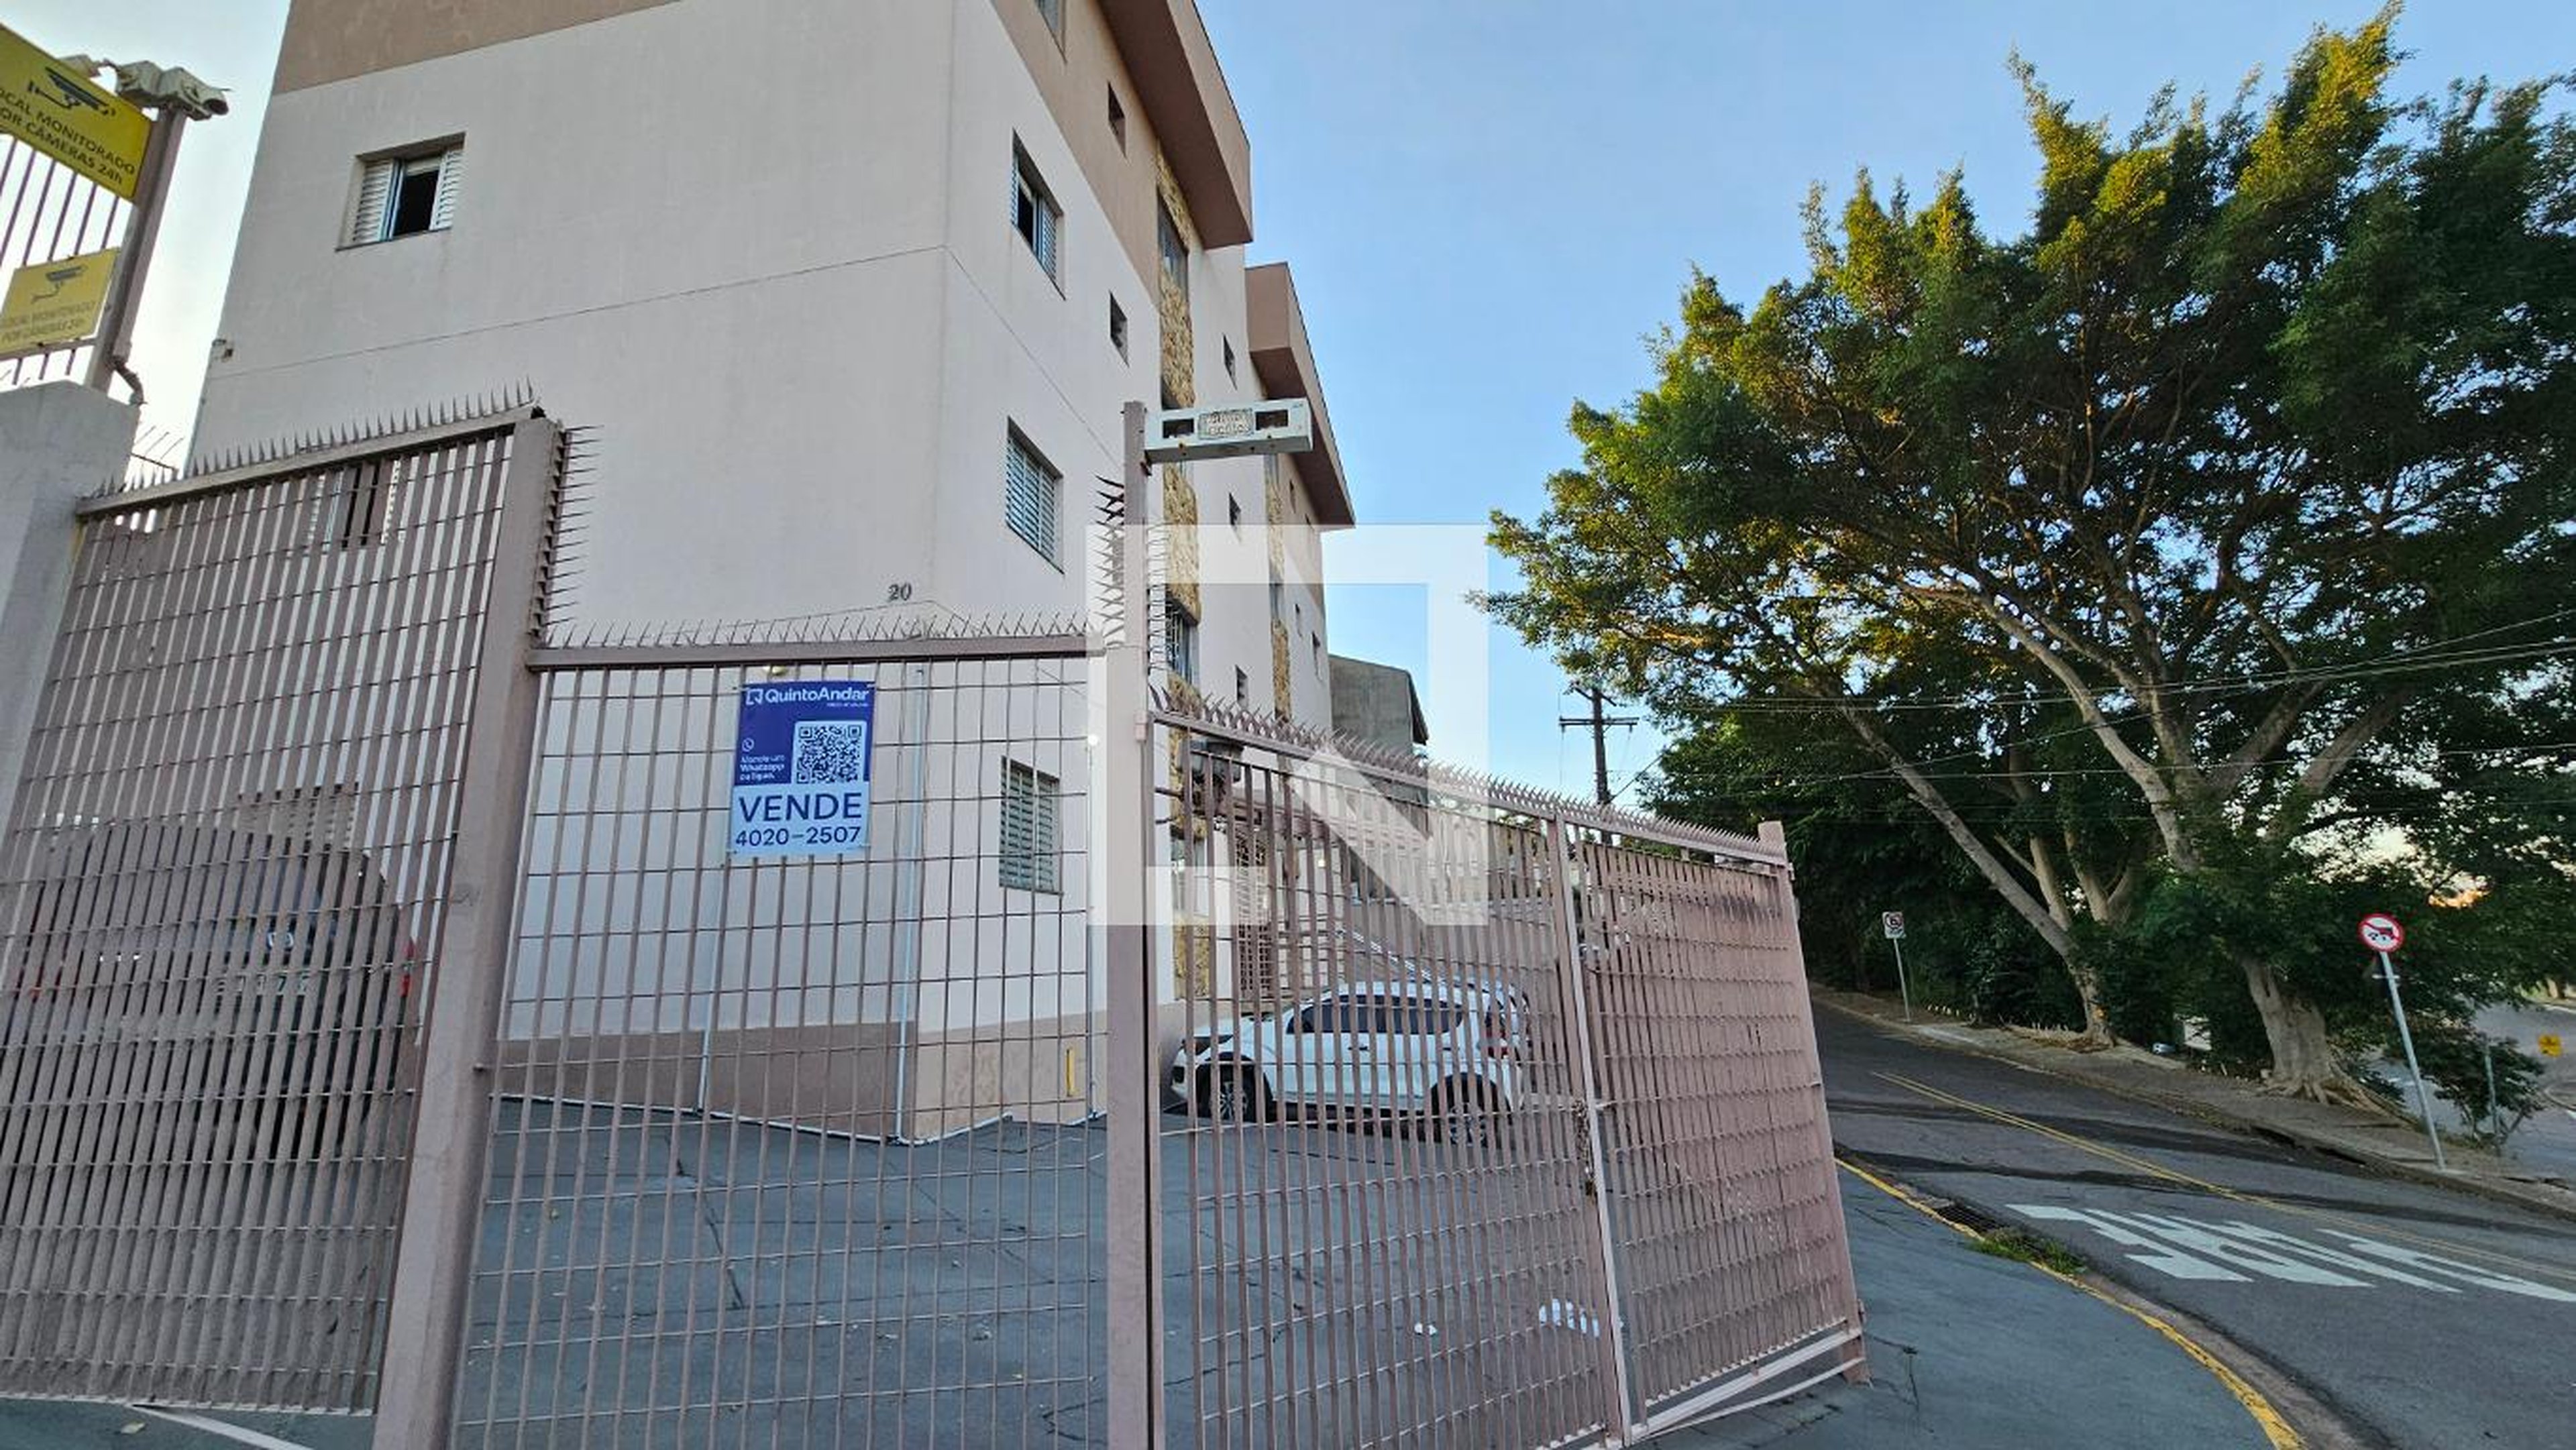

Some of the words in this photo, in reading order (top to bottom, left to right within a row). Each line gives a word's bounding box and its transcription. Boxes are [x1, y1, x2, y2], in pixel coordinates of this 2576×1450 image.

[37, 111, 135, 174] MONITORADO
[888, 582, 912, 601] 20
[765, 687, 869, 703] QuintoAndar
[739, 793, 862, 822] VENDE
[735, 826, 861, 846] 4020-2507
